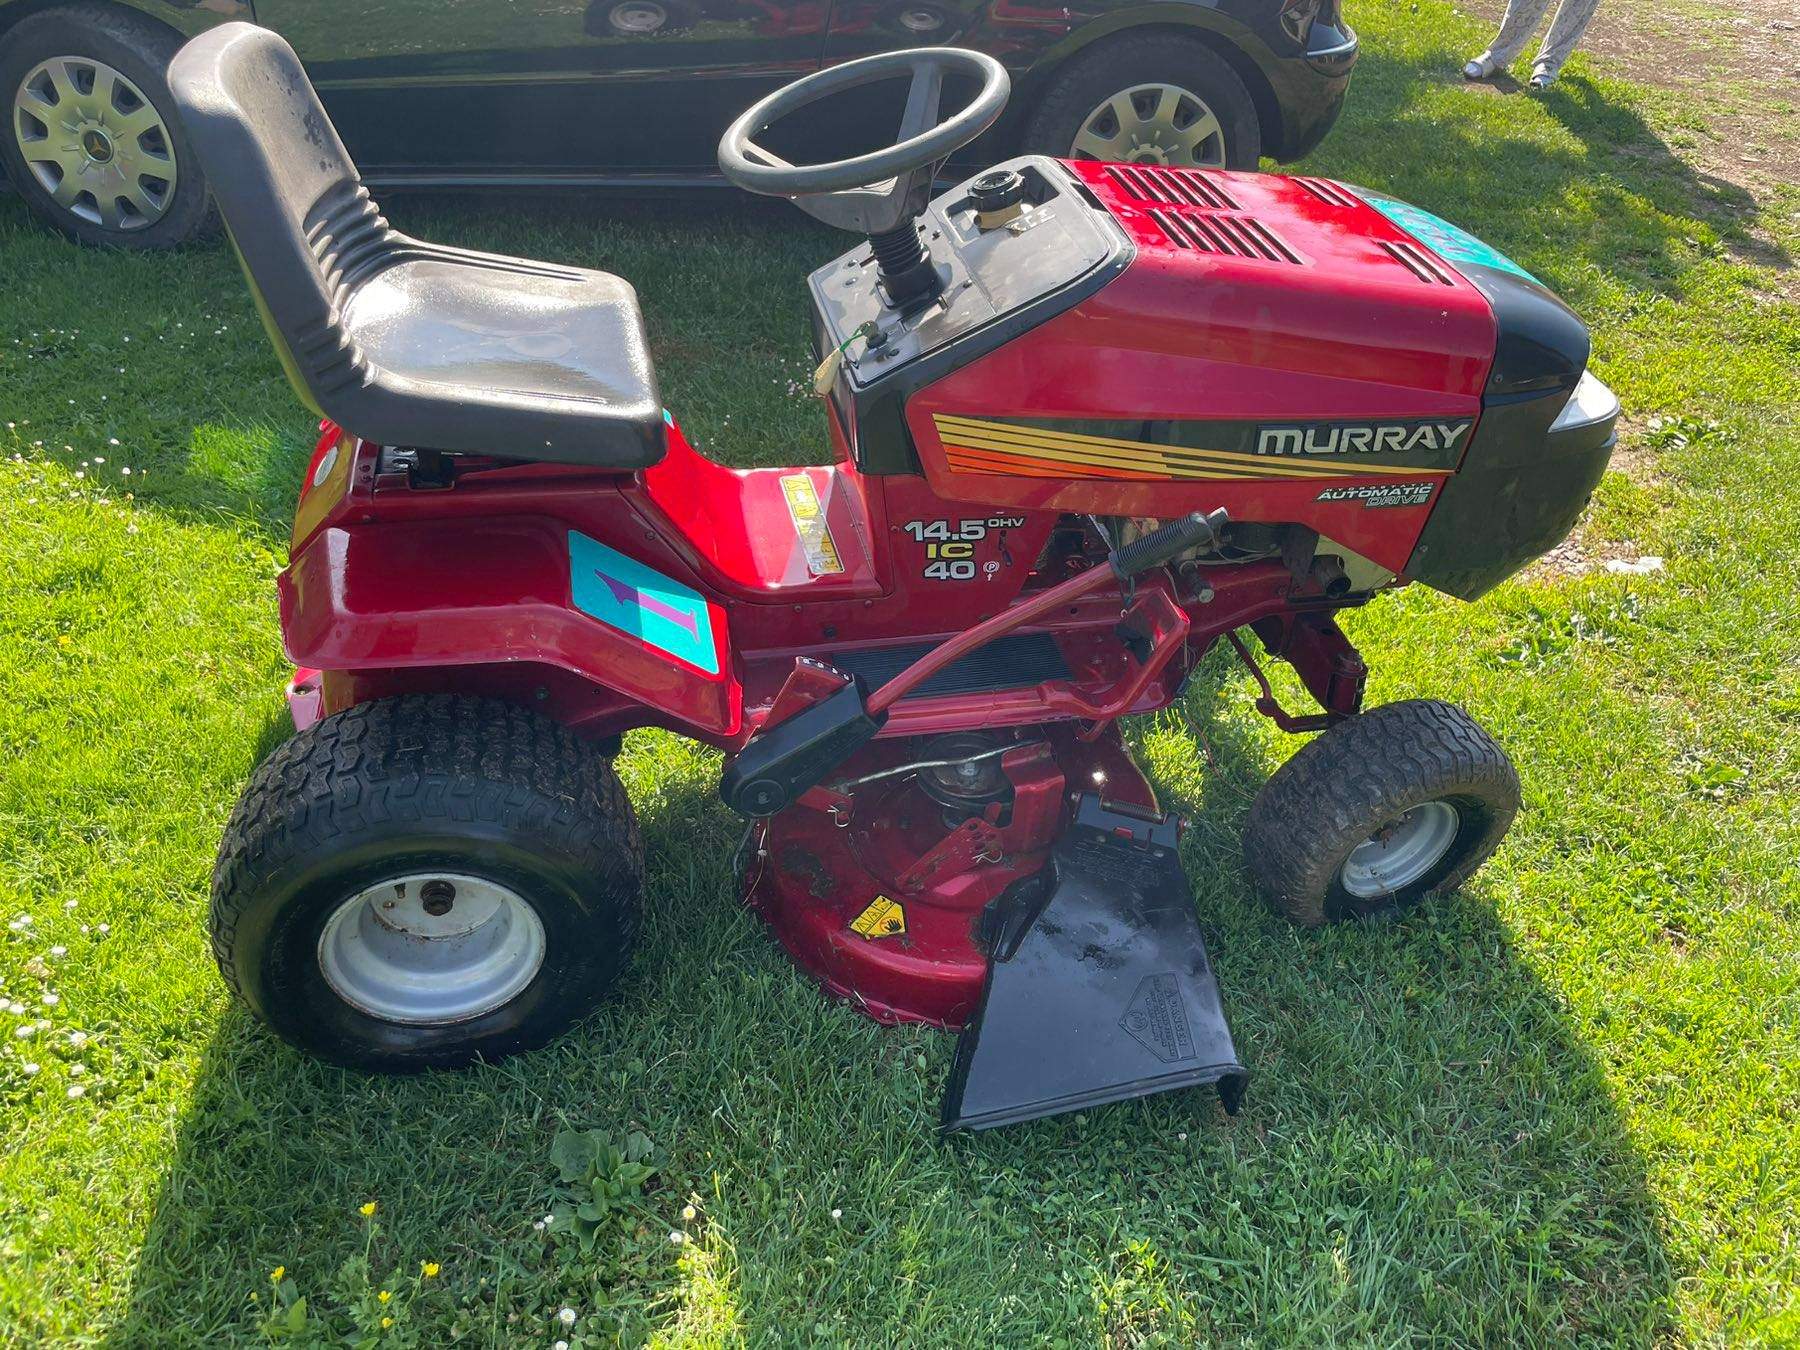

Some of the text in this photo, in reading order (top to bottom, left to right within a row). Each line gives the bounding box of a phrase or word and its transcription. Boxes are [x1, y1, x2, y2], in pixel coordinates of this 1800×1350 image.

[1258, 423, 1470, 454] MURRAY
[1316, 485, 1433, 500] AUTOMATIC
[1365, 494, 1429, 507] DRIVE
[904, 518, 1024, 541] 14.5 OHV
[927, 543, 973, 559] IC
[924, 561, 975, 580] 40
